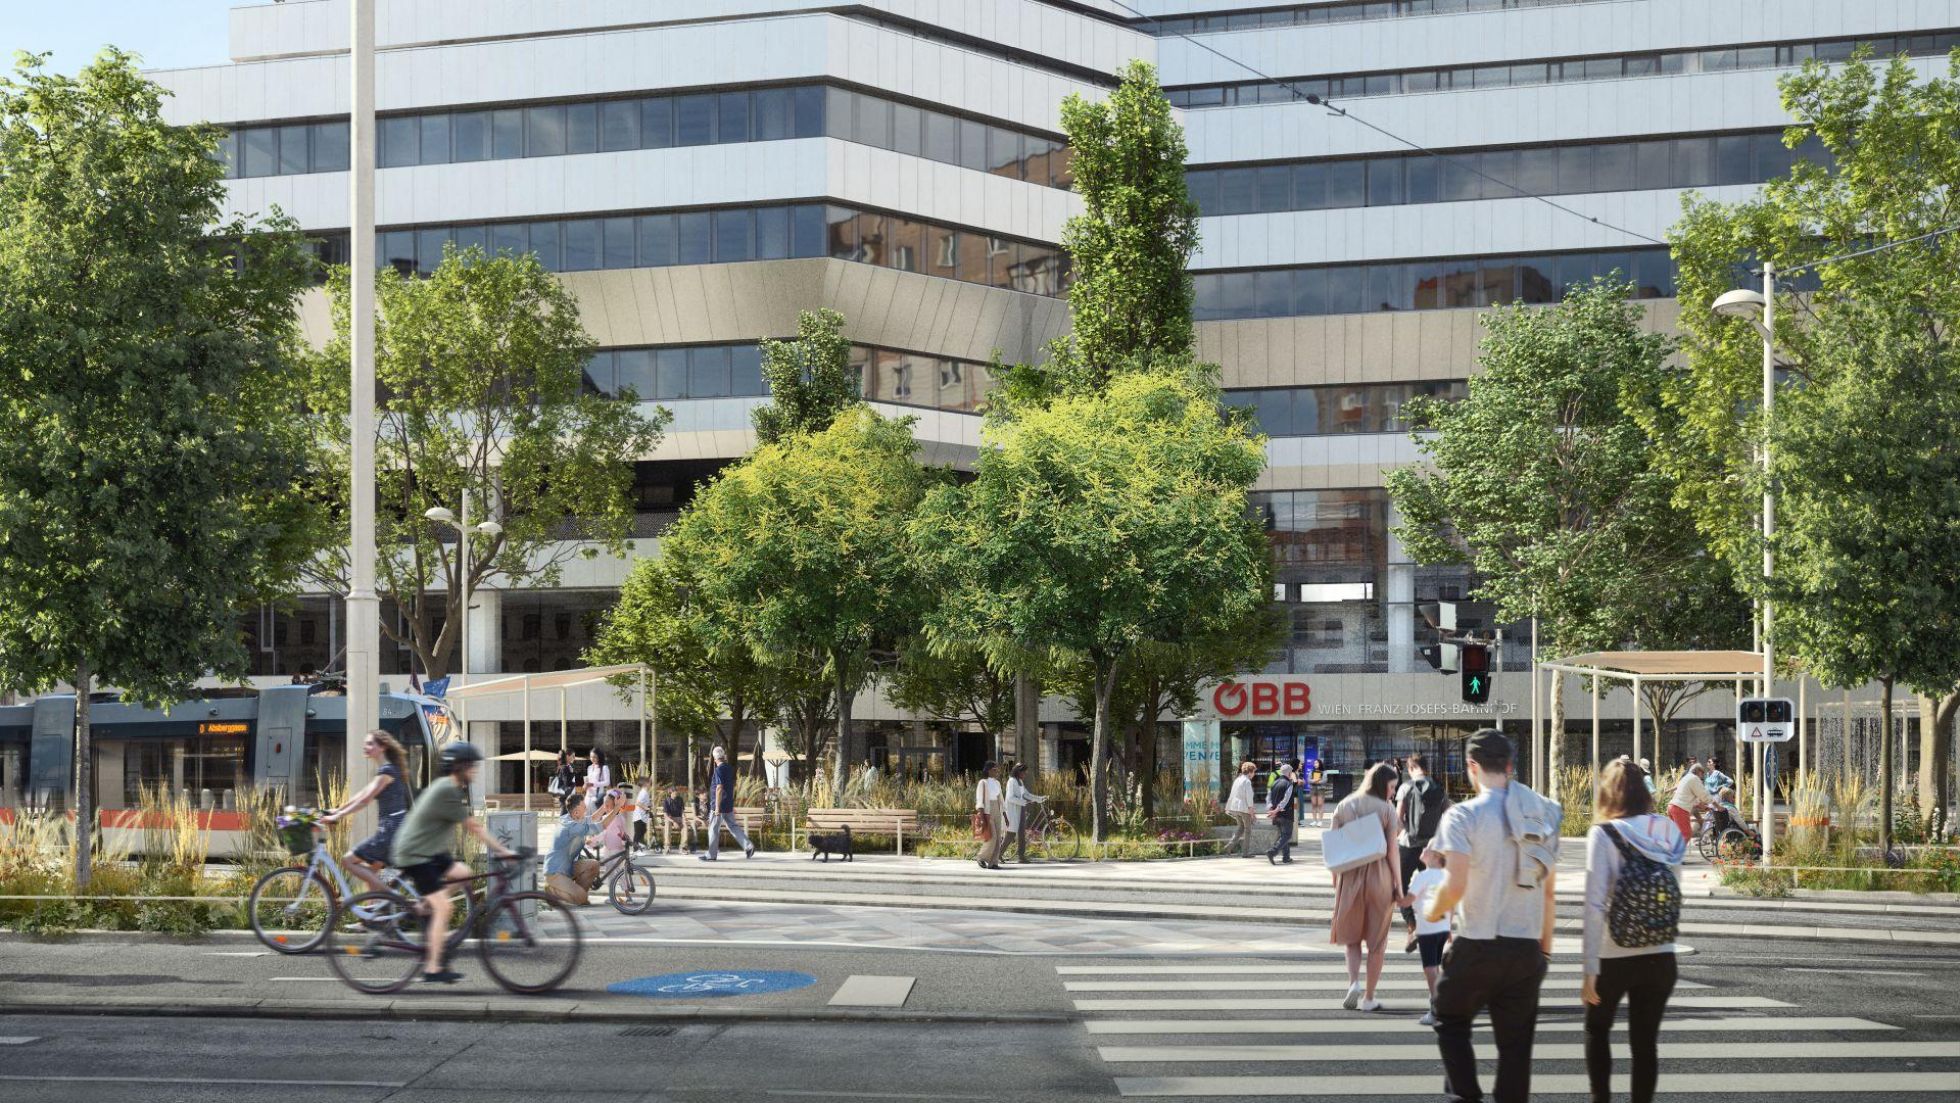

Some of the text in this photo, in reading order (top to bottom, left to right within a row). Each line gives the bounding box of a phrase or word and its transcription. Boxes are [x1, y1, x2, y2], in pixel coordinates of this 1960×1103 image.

[1213, 682, 1312, 716] ÖBB
[1318, 702, 1518, 714] WIEN FRANZ JOSEFS-BAHNOF
